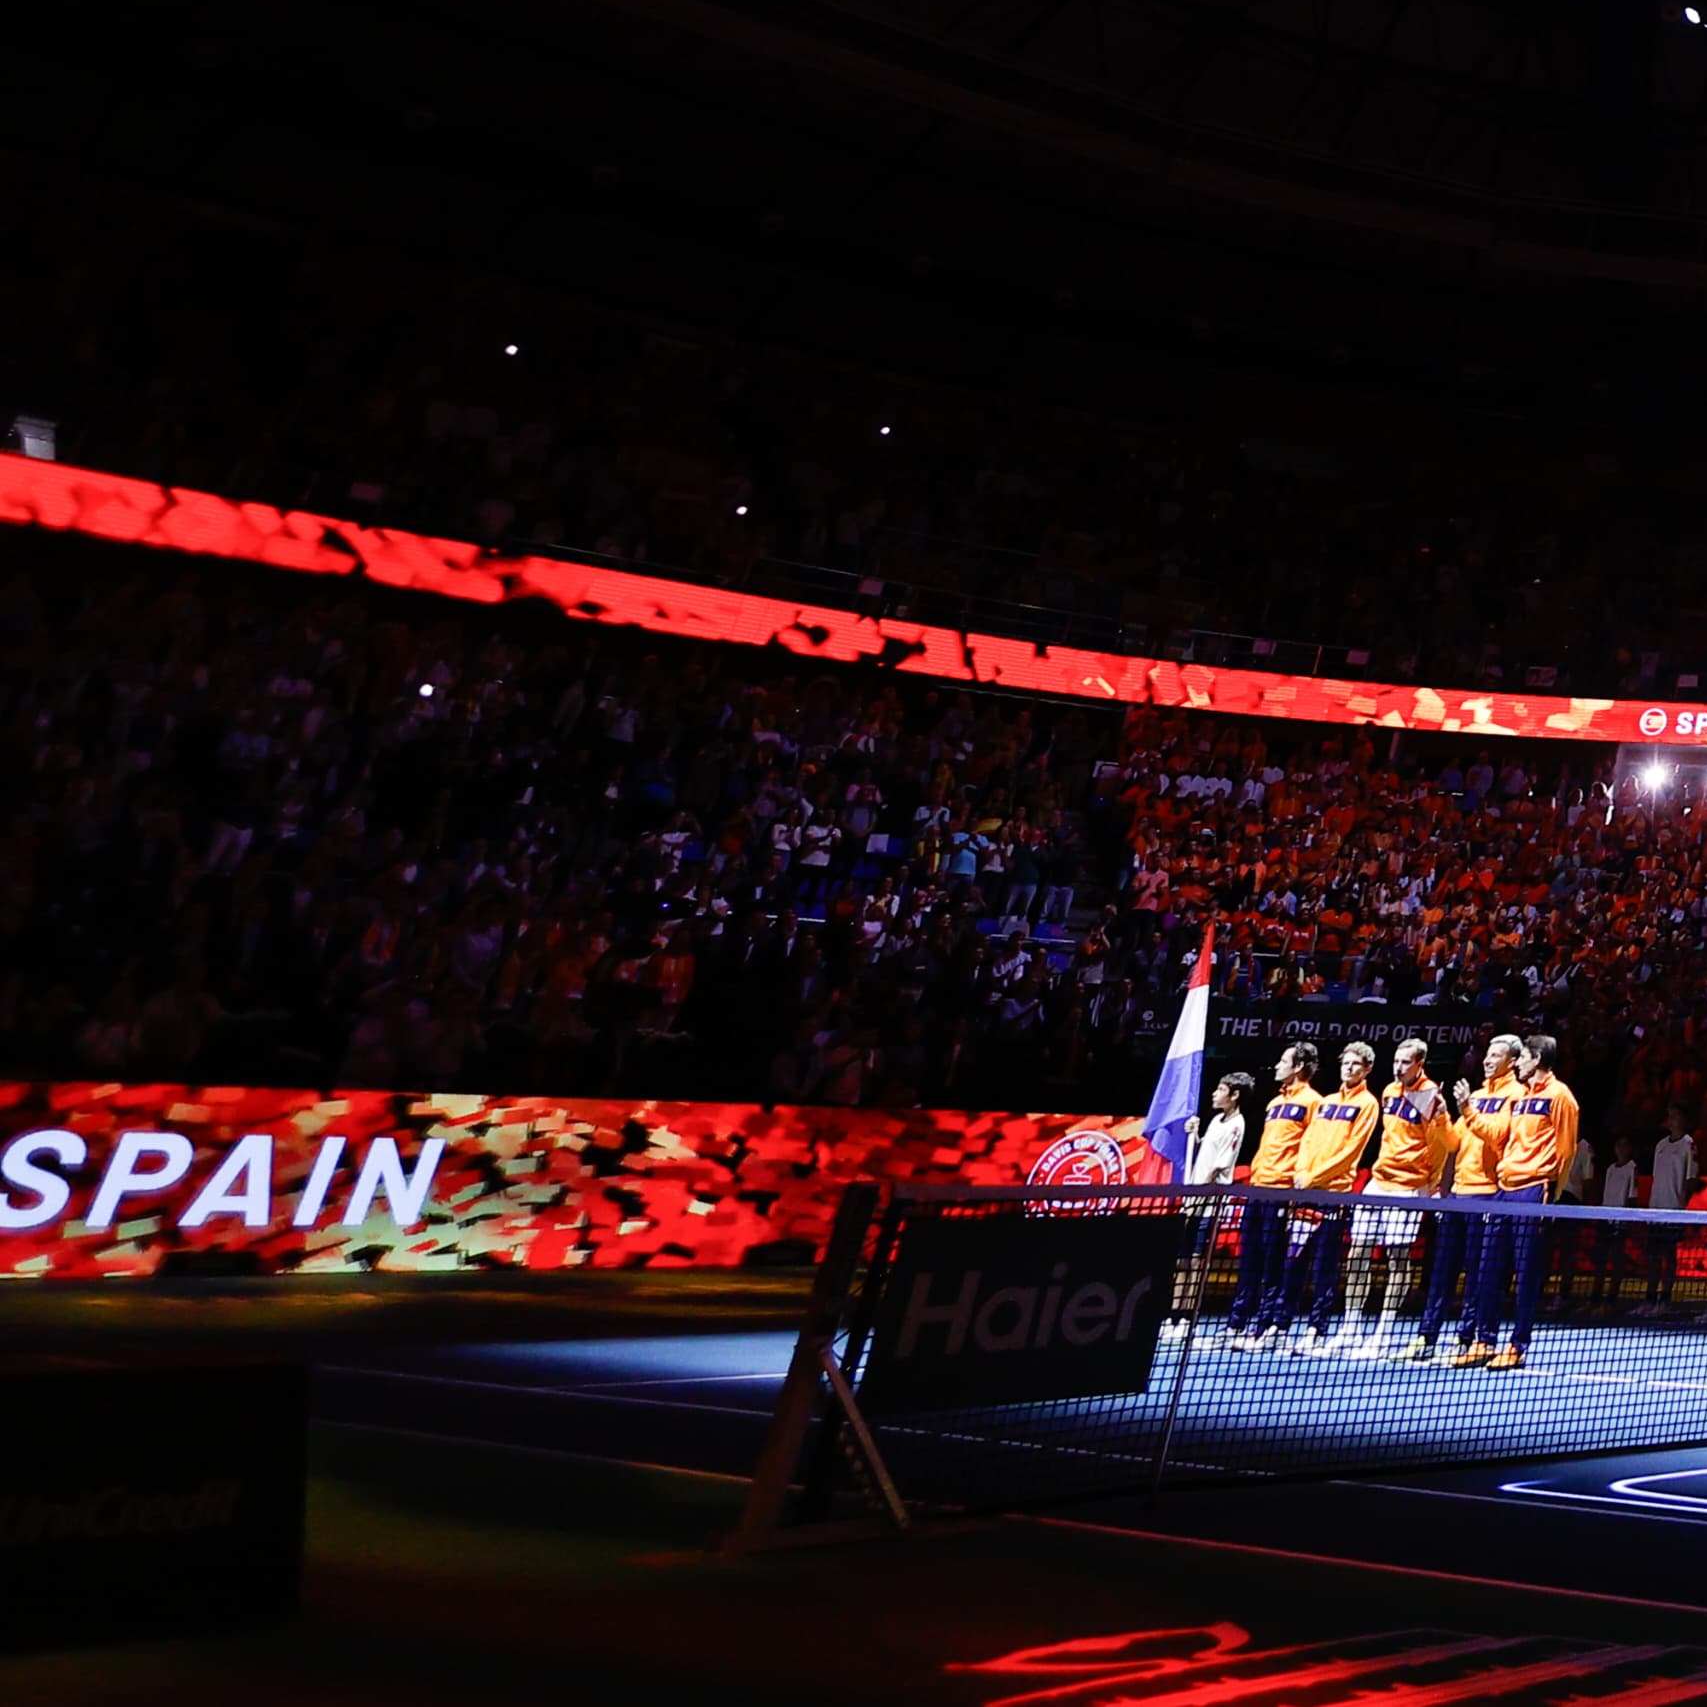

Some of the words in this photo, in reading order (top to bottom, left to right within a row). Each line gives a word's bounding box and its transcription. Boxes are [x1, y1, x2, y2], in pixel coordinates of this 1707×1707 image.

[1219, 1016, 1263, 1038] THE
[1346, 1023, 1390, 1042] CUP
[1392, 1024, 1423, 1043] OF
[1425, 1025, 1477, 1045] TENN
[0, 1130, 447, 1229] SPAIN
[894, 1261, 1162, 1360] Haier
